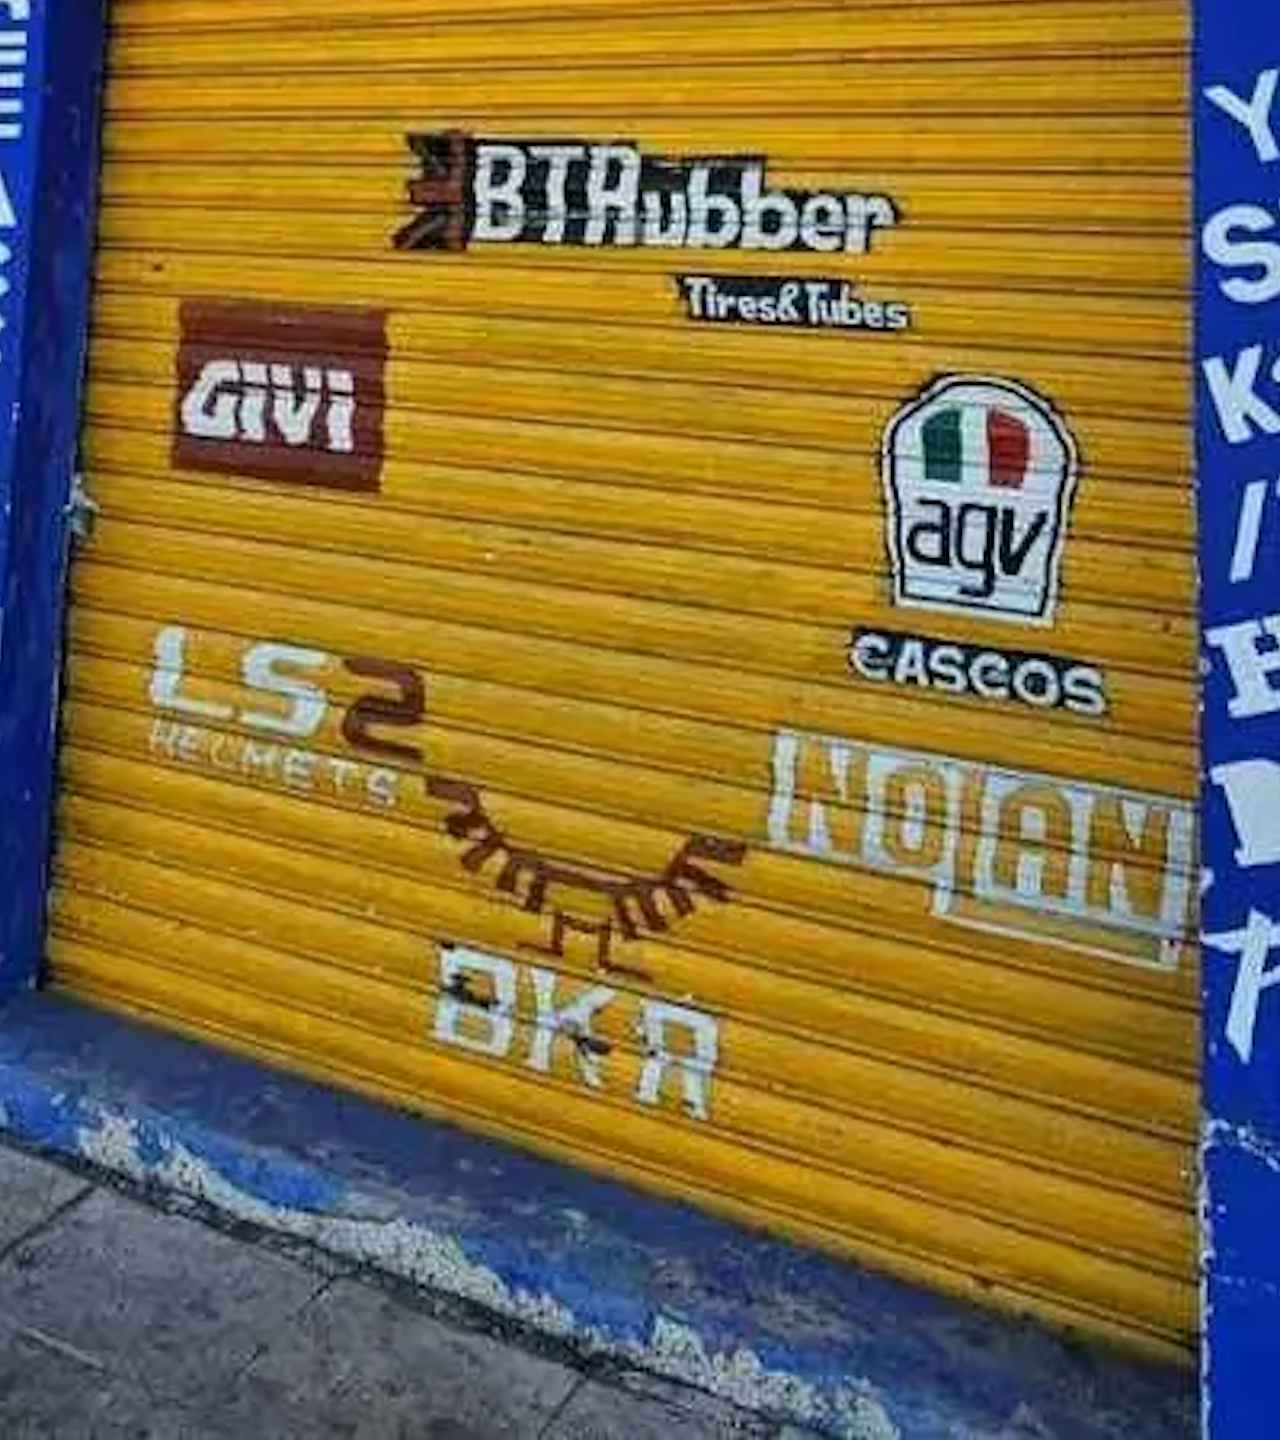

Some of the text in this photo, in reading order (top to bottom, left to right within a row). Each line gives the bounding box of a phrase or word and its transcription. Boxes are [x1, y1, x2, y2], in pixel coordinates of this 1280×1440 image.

[906, 499, 1049, 598] agv
[149, 626, 427, 762] LS2
[851, 633, 1107, 716] CASCOS
[149, 717, 400, 810] HELMETS
